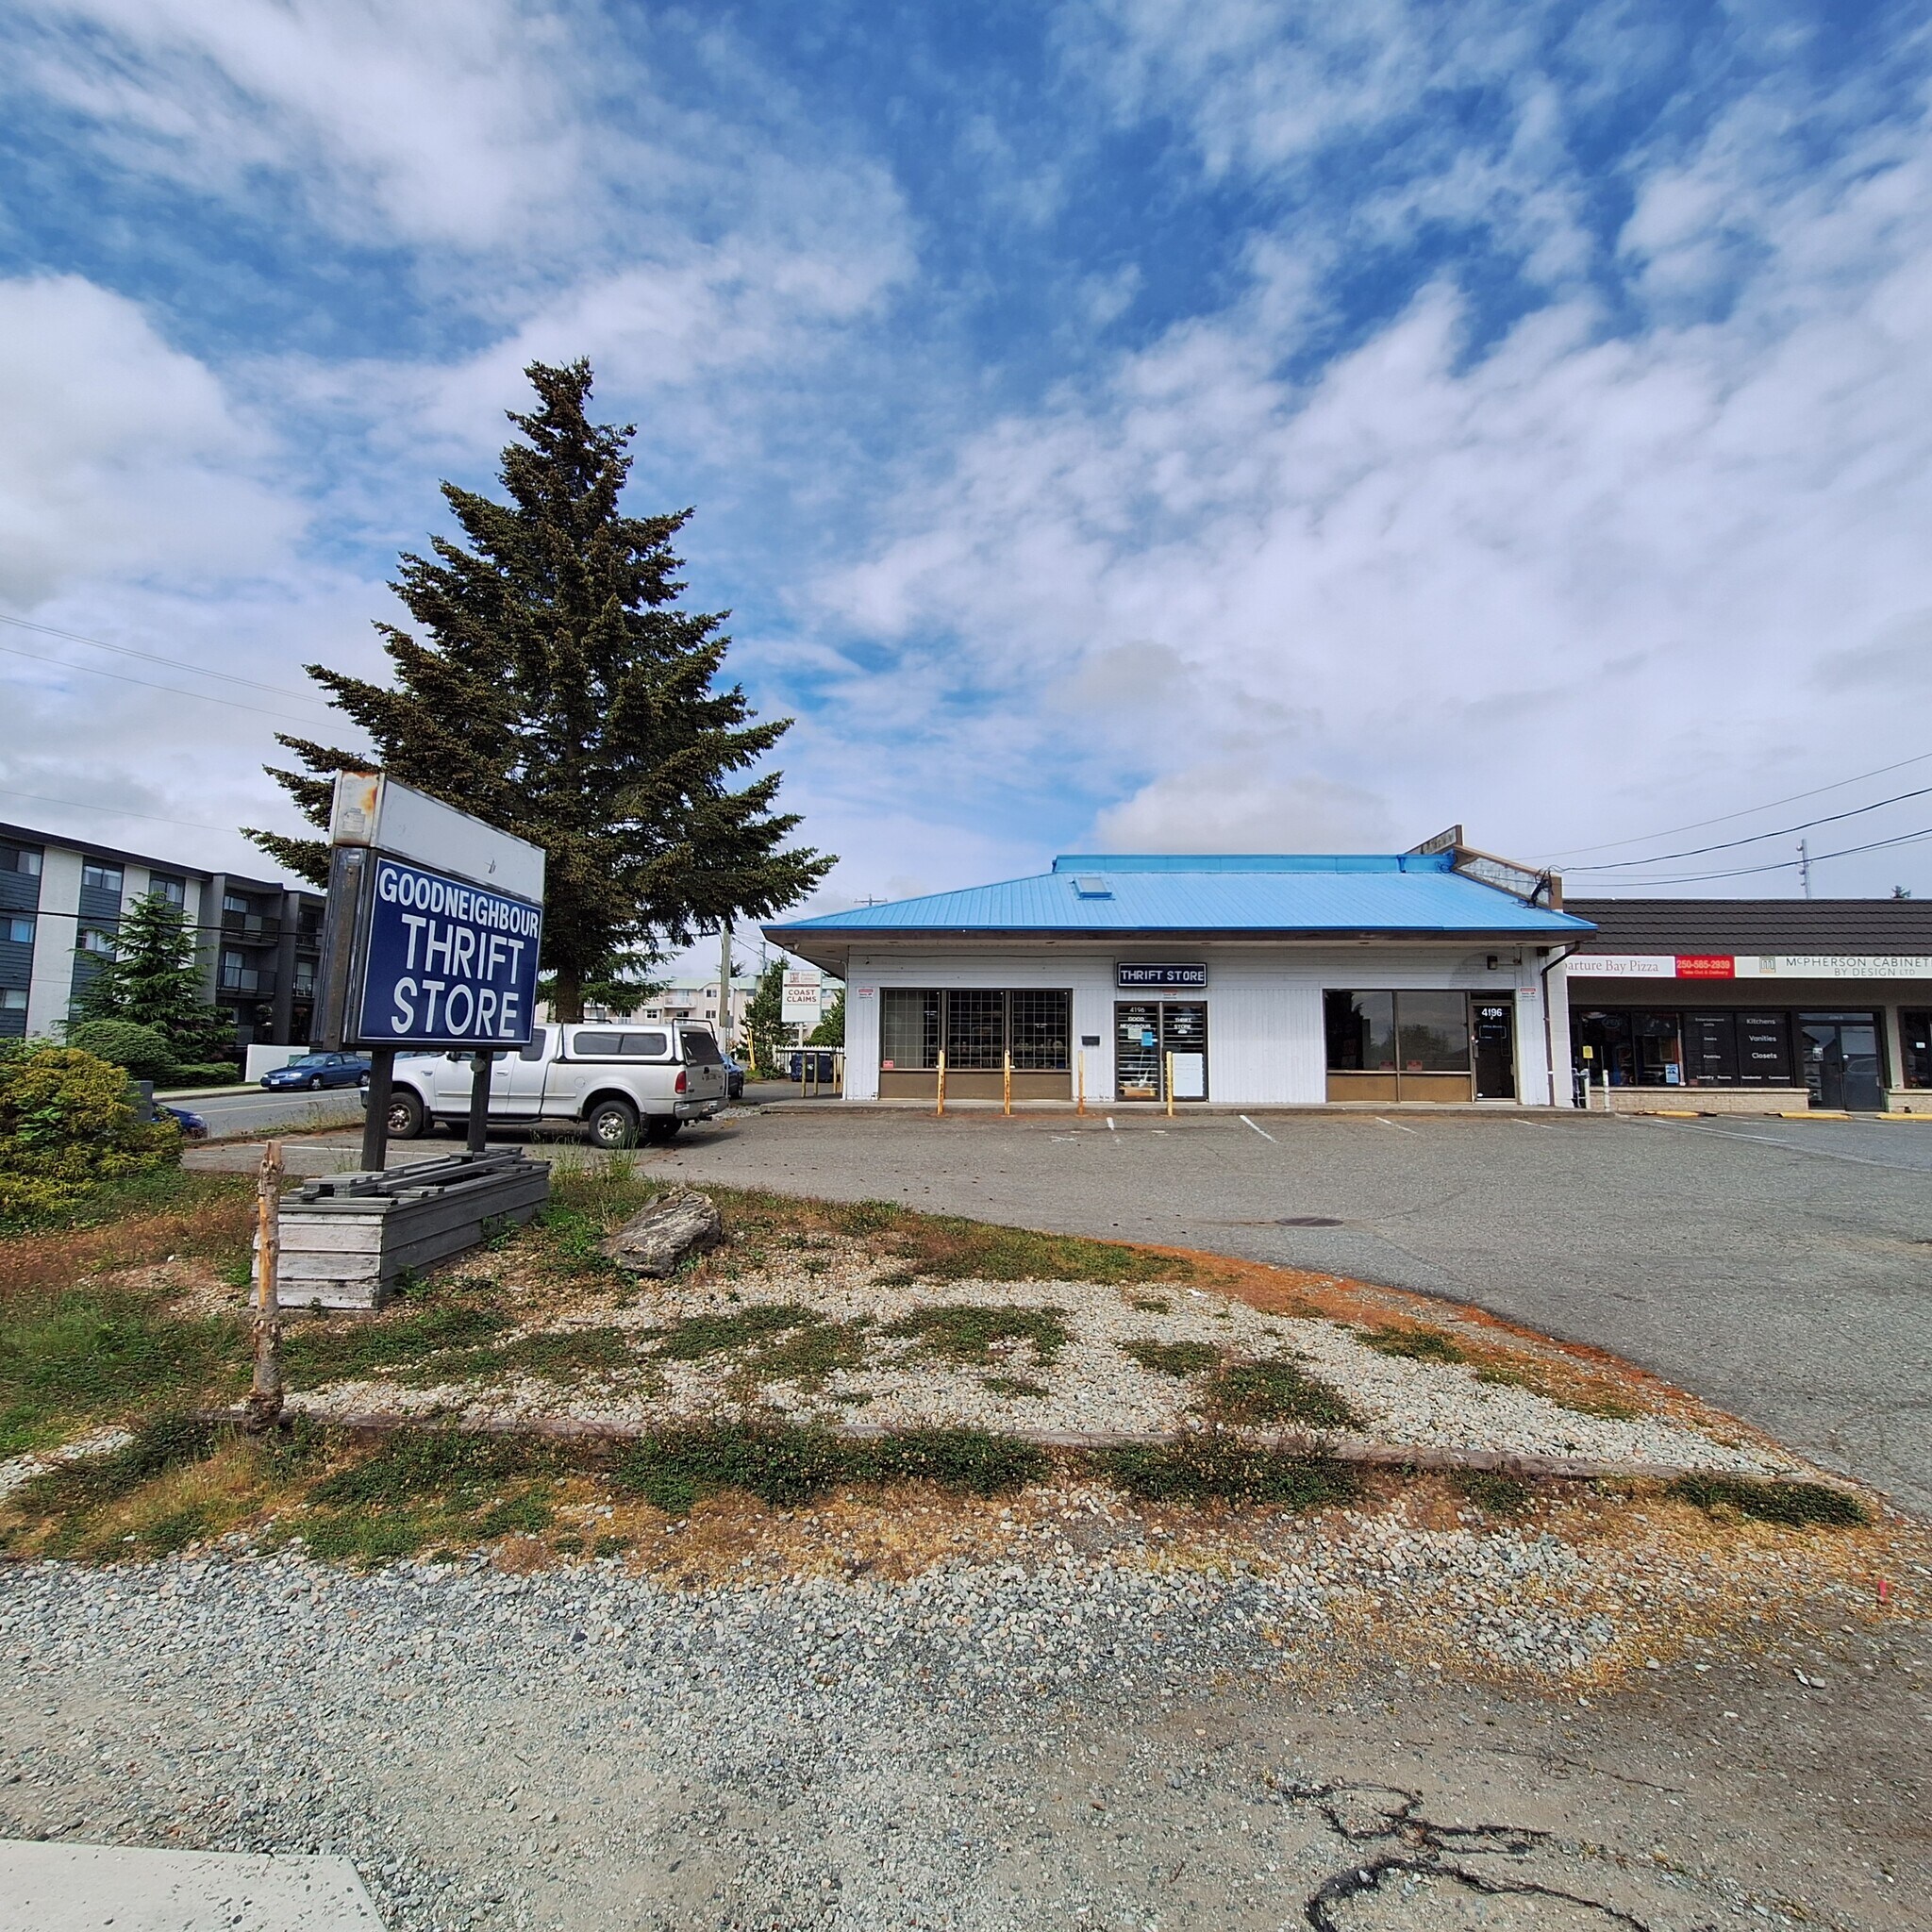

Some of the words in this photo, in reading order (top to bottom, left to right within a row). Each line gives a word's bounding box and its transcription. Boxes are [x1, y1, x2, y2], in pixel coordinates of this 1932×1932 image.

[379, 867, 539, 939] GOODNEIGHBOUR
[401, 913, 525, 984] THRIFT
[1605, 959, 1626, 974] Bay
[1629, 959, 1659, 972] Pizza
[1874, 958, 1932, 967] CABINET
[1120, 970, 1163, 980] THRIFT
[1166, 970, 1205, 981] STORE
[1834, 968, 1848, 976] BY
[1852, 968, 1895, 976] DESIGN
[1899, 968, 1916, 976] LTD
[391, 976, 519, 1038] STORE
[1481, 1008, 1503, 1017] 4196
